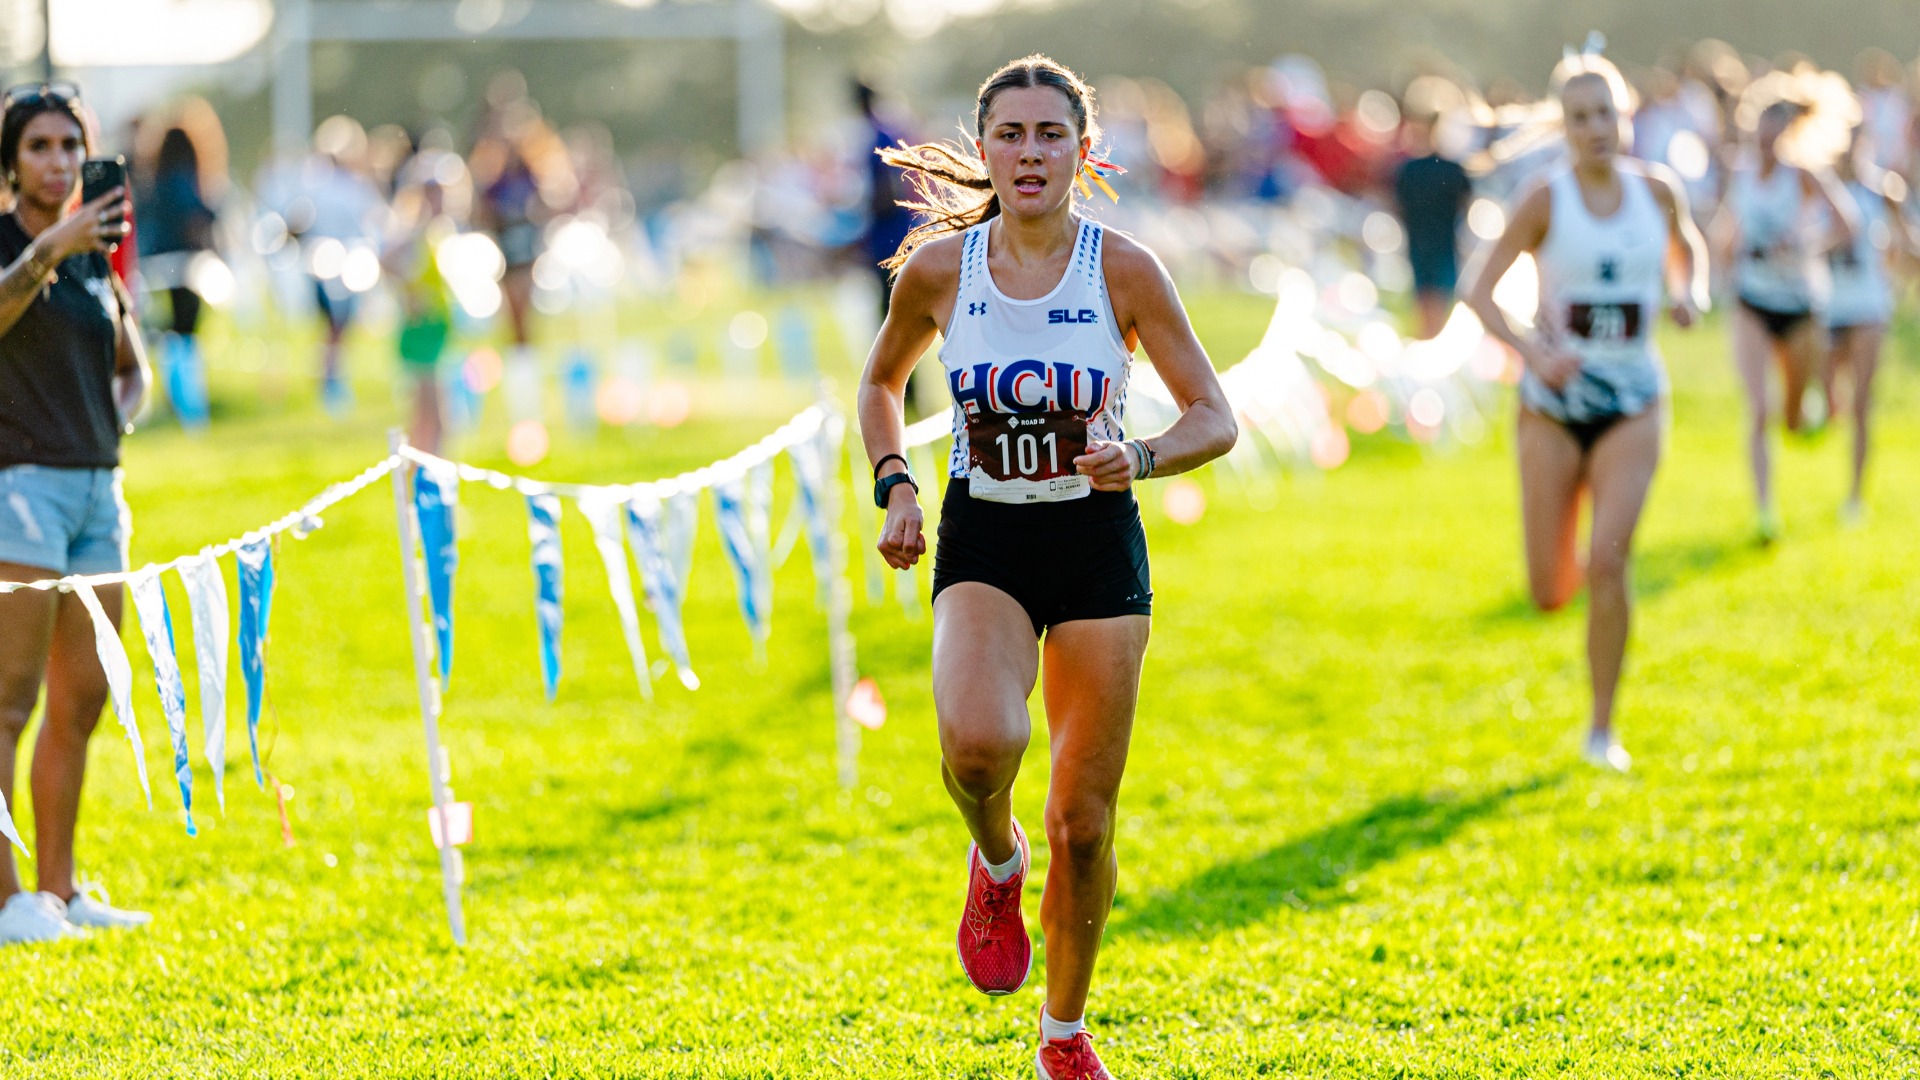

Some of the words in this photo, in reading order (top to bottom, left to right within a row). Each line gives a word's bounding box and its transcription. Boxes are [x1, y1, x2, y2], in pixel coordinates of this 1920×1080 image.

[1048, 309, 1094, 324] SLC
[950, 359, 1109, 421] HCU
[996, 432, 1058, 475] 101
